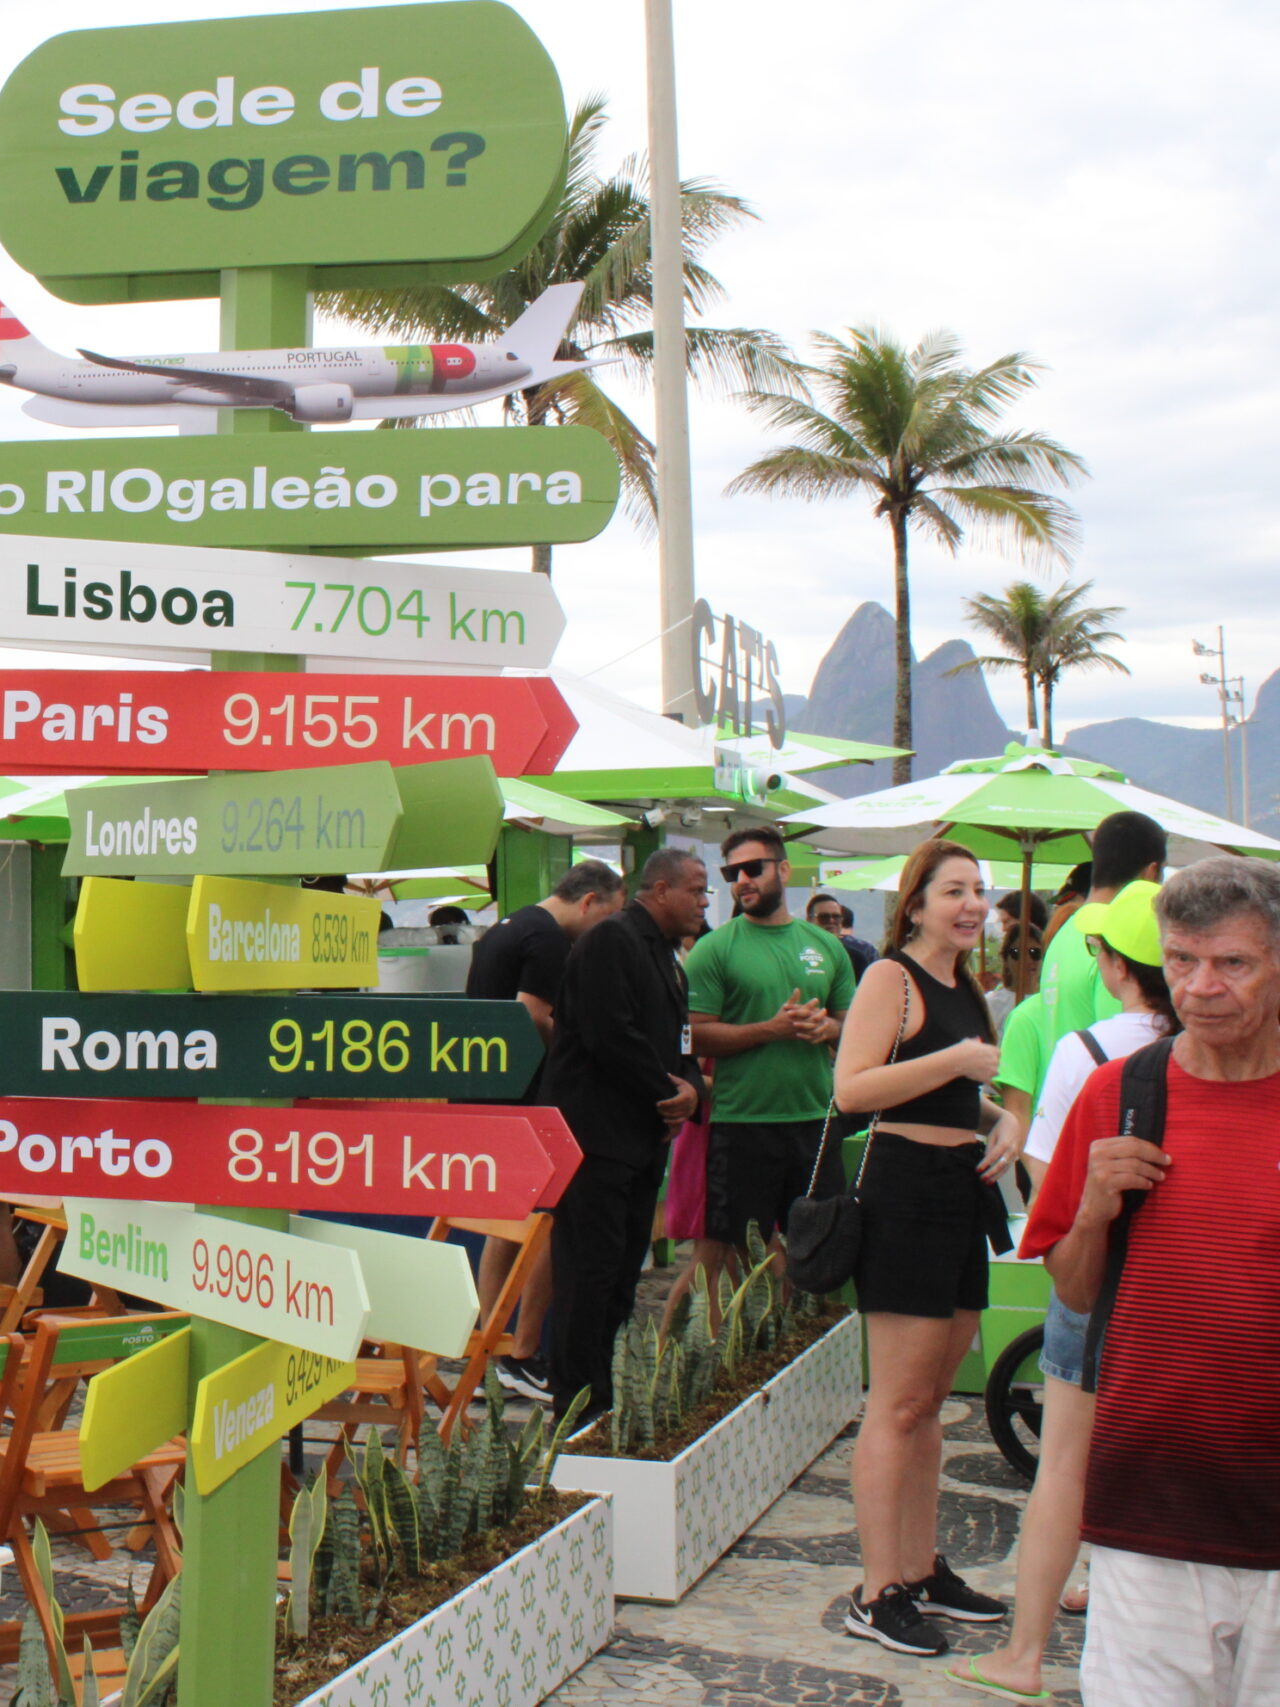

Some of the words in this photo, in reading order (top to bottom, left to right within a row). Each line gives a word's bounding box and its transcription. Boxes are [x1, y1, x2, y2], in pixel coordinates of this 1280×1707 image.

[57, 76, 295, 137] Sede
[320, 66, 442, 122] de
[54, 131, 487, 211] viagem?
[287, 351, 362, 364] PORTUGAL
[45, 467, 398, 522] RIOgaleão
[420, 468, 582, 517] para
[26, 563, 235, 628] Lisboa
[284, 580, 431, 639] 7.704
[450, 591, 526, 646] km
[2, 689, 169, 744] Paris
[222, 693, 379, 748] 9.155
[402, 697, 496, 751] km
[85, 806, 198, 858] Londres
[220, 796, 306, 854] 9.264
[316, 794, 366, 849] km
[209, 903, 300, 962] Barcelona
[312, 912, 348, 963] 8.539
[351, 916, 370, 962] km
[41, 1017, 219, 1072] Roma
[267, 1018, 411, 1075] 9.186
[430, 1021, 508, 1073] km
[227, 1127, 374, 1187] 8.191
[402, 1134, 497, 1193] km
[78, 1212, 169, 1283] Berlim
[192, 1238, 275, 1309] 9.996
[286, 1258, 334, 1327] km
[122, 1334, 154, 1344] POSTO
[213, 1383, 274, 1460] Veneza
